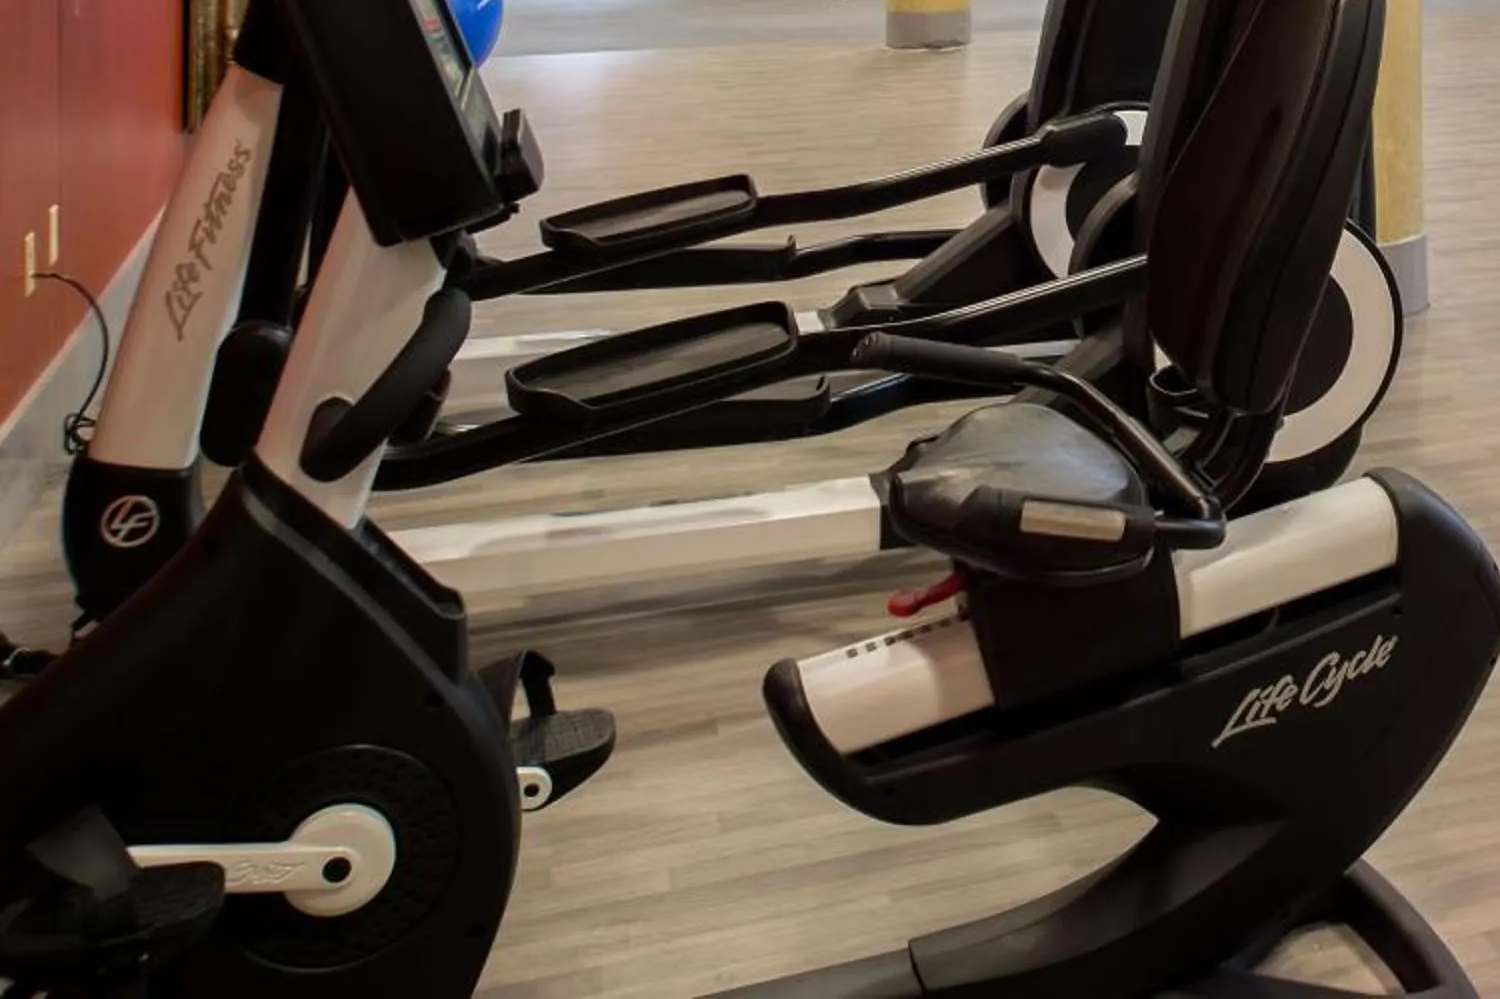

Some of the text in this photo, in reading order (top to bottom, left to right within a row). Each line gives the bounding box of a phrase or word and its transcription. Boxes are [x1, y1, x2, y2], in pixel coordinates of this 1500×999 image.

[164, 138, 253, 343] Life Fitness
[1210, 634, 1399, 749] Life Cycle
